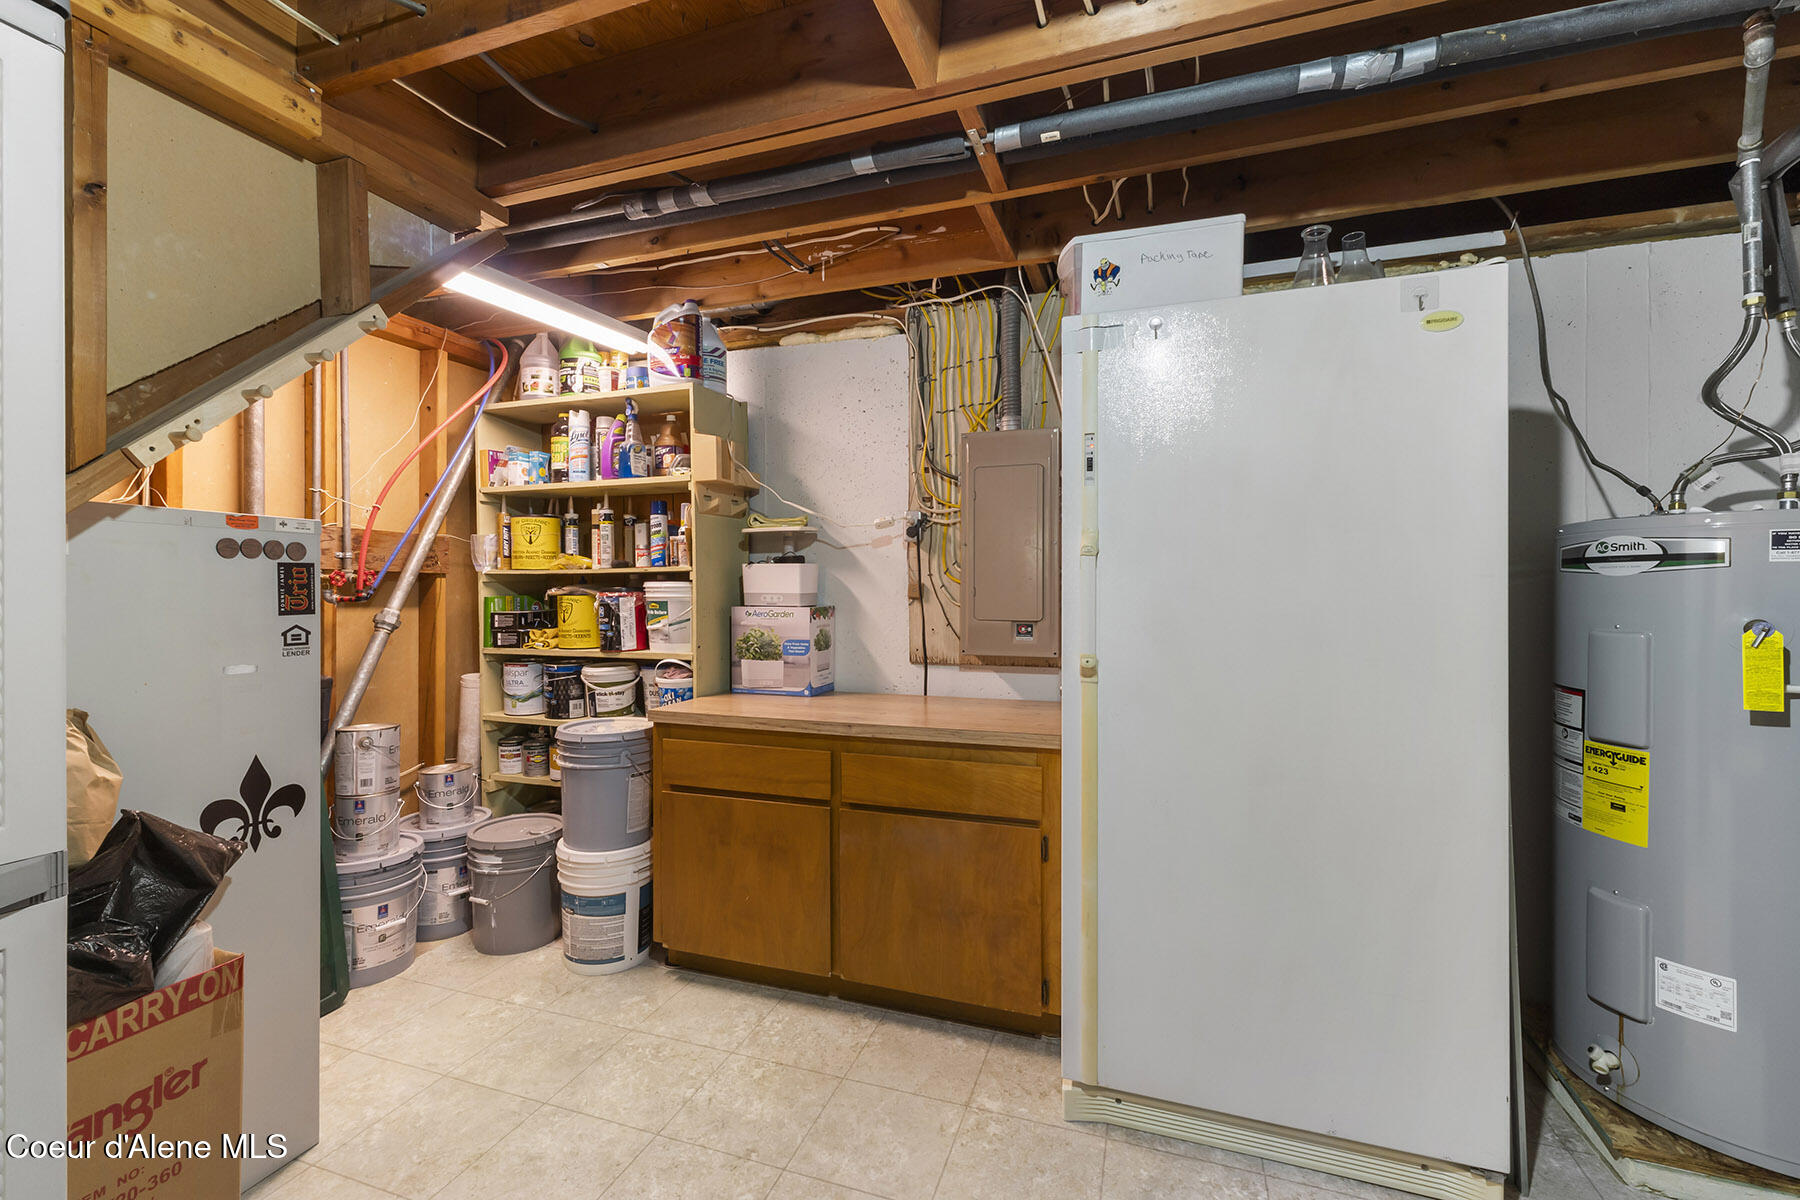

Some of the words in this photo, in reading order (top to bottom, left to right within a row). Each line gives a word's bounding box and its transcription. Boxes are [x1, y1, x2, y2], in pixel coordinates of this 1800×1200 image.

[1187, 249, 1213, 259] Tape
[570, 431, 589, 442] Lysol
[1610, 542, 1645, 552] Smith
[751, 610, 794, 618] AeroGarden
[1592, 766, 1609, 776] 423
[428, 785, 469, 799] Emerald
[337, 813, 386, 826] Emerald
[67, 958, 242, 1055] CARRY-ON
[67, 1057, 208, 1150] angler
[116, 1166, 145, 1188] NO:
